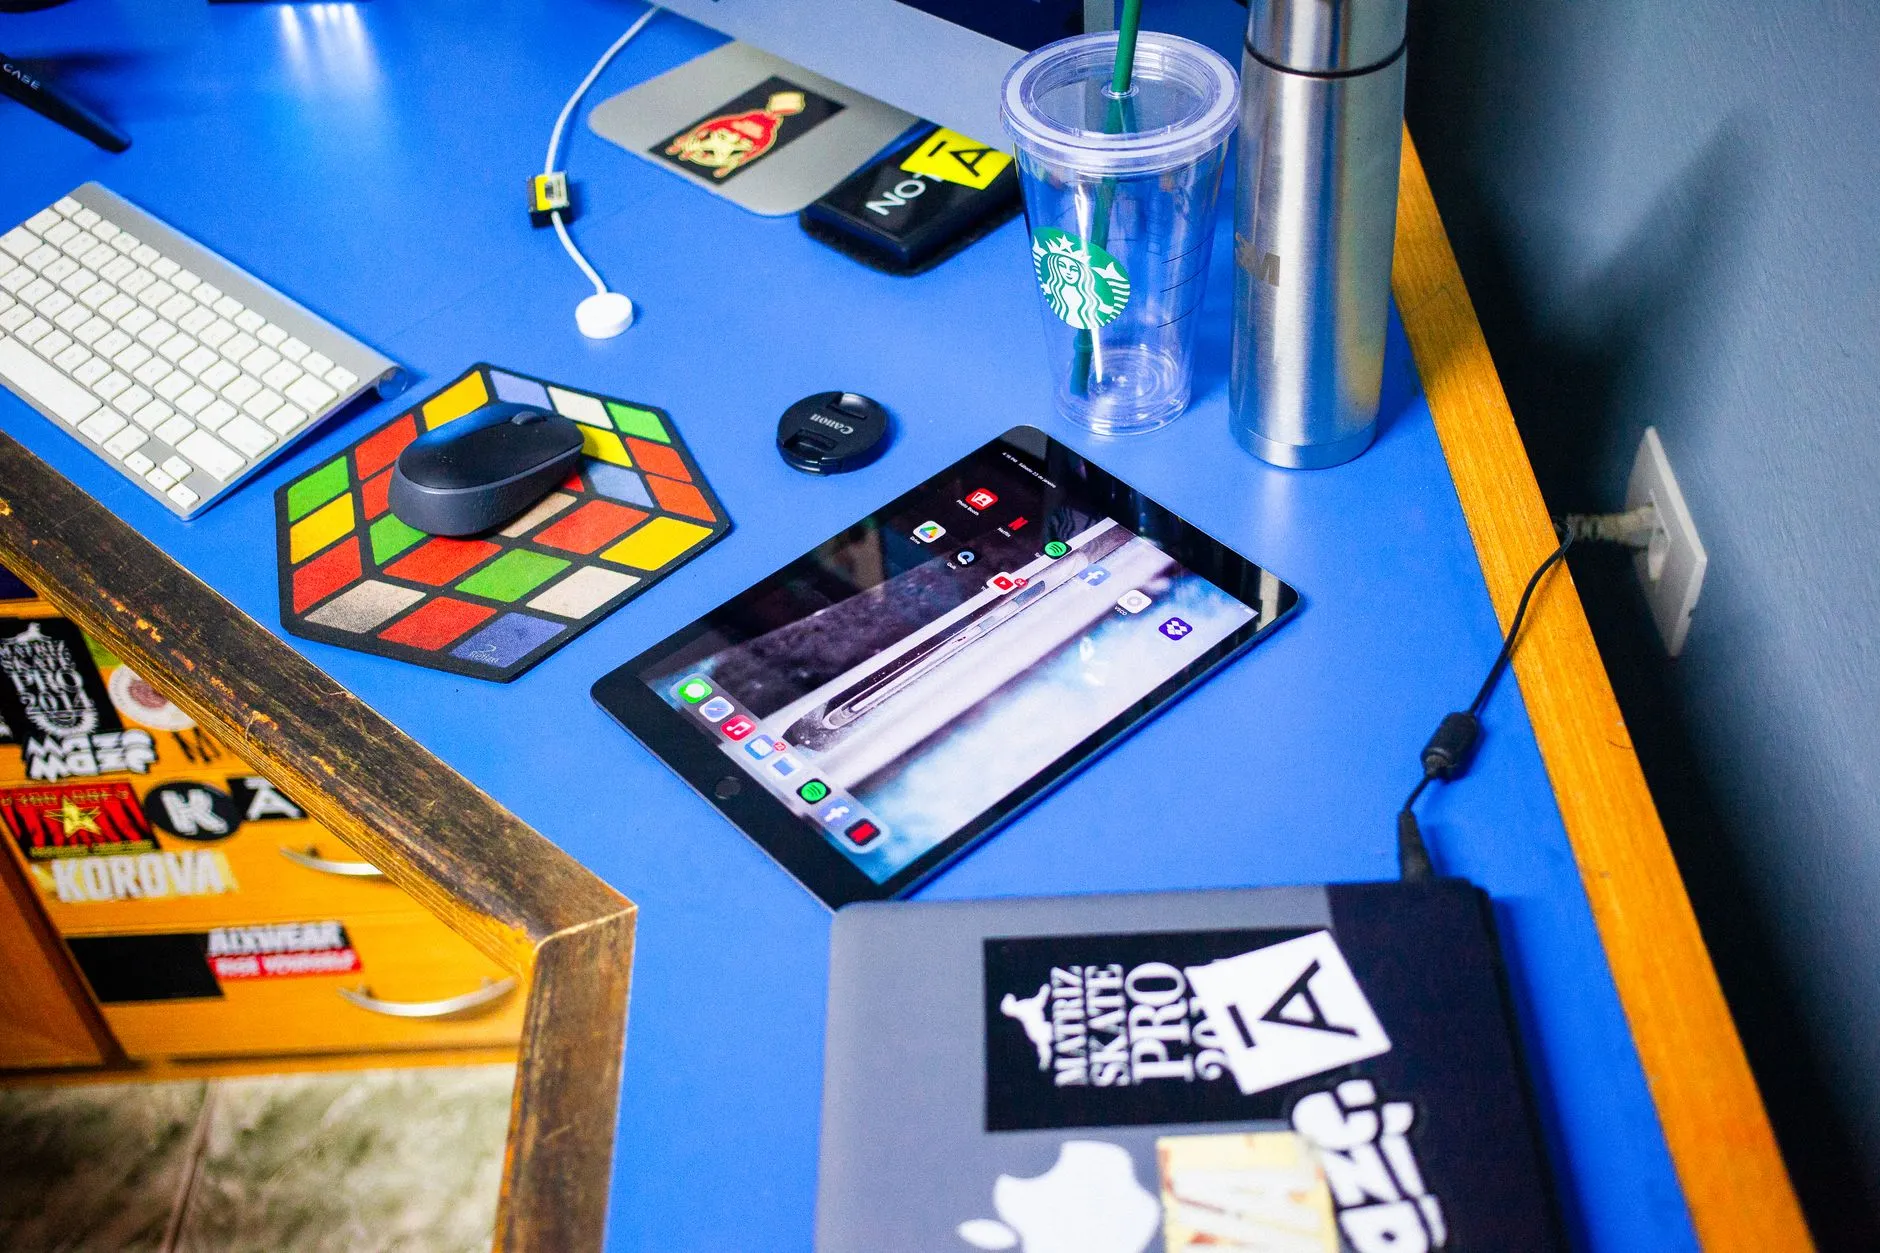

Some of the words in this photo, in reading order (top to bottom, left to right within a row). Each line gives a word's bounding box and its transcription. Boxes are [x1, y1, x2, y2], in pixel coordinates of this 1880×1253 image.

[809, 413, 854, 435] Canon
[1114, 605, 1128, 616] VSCO
[12, 668, 83, 694] PRO
[21, 690, 96, 714] 2014
[51, 851, 227, 903] KOROVA
[1050, 965, 1087, 1087] MATRIZ
[1084, 964, 1132, 1087] SKATE
[1124, 961, 1195, 1083] PRO
